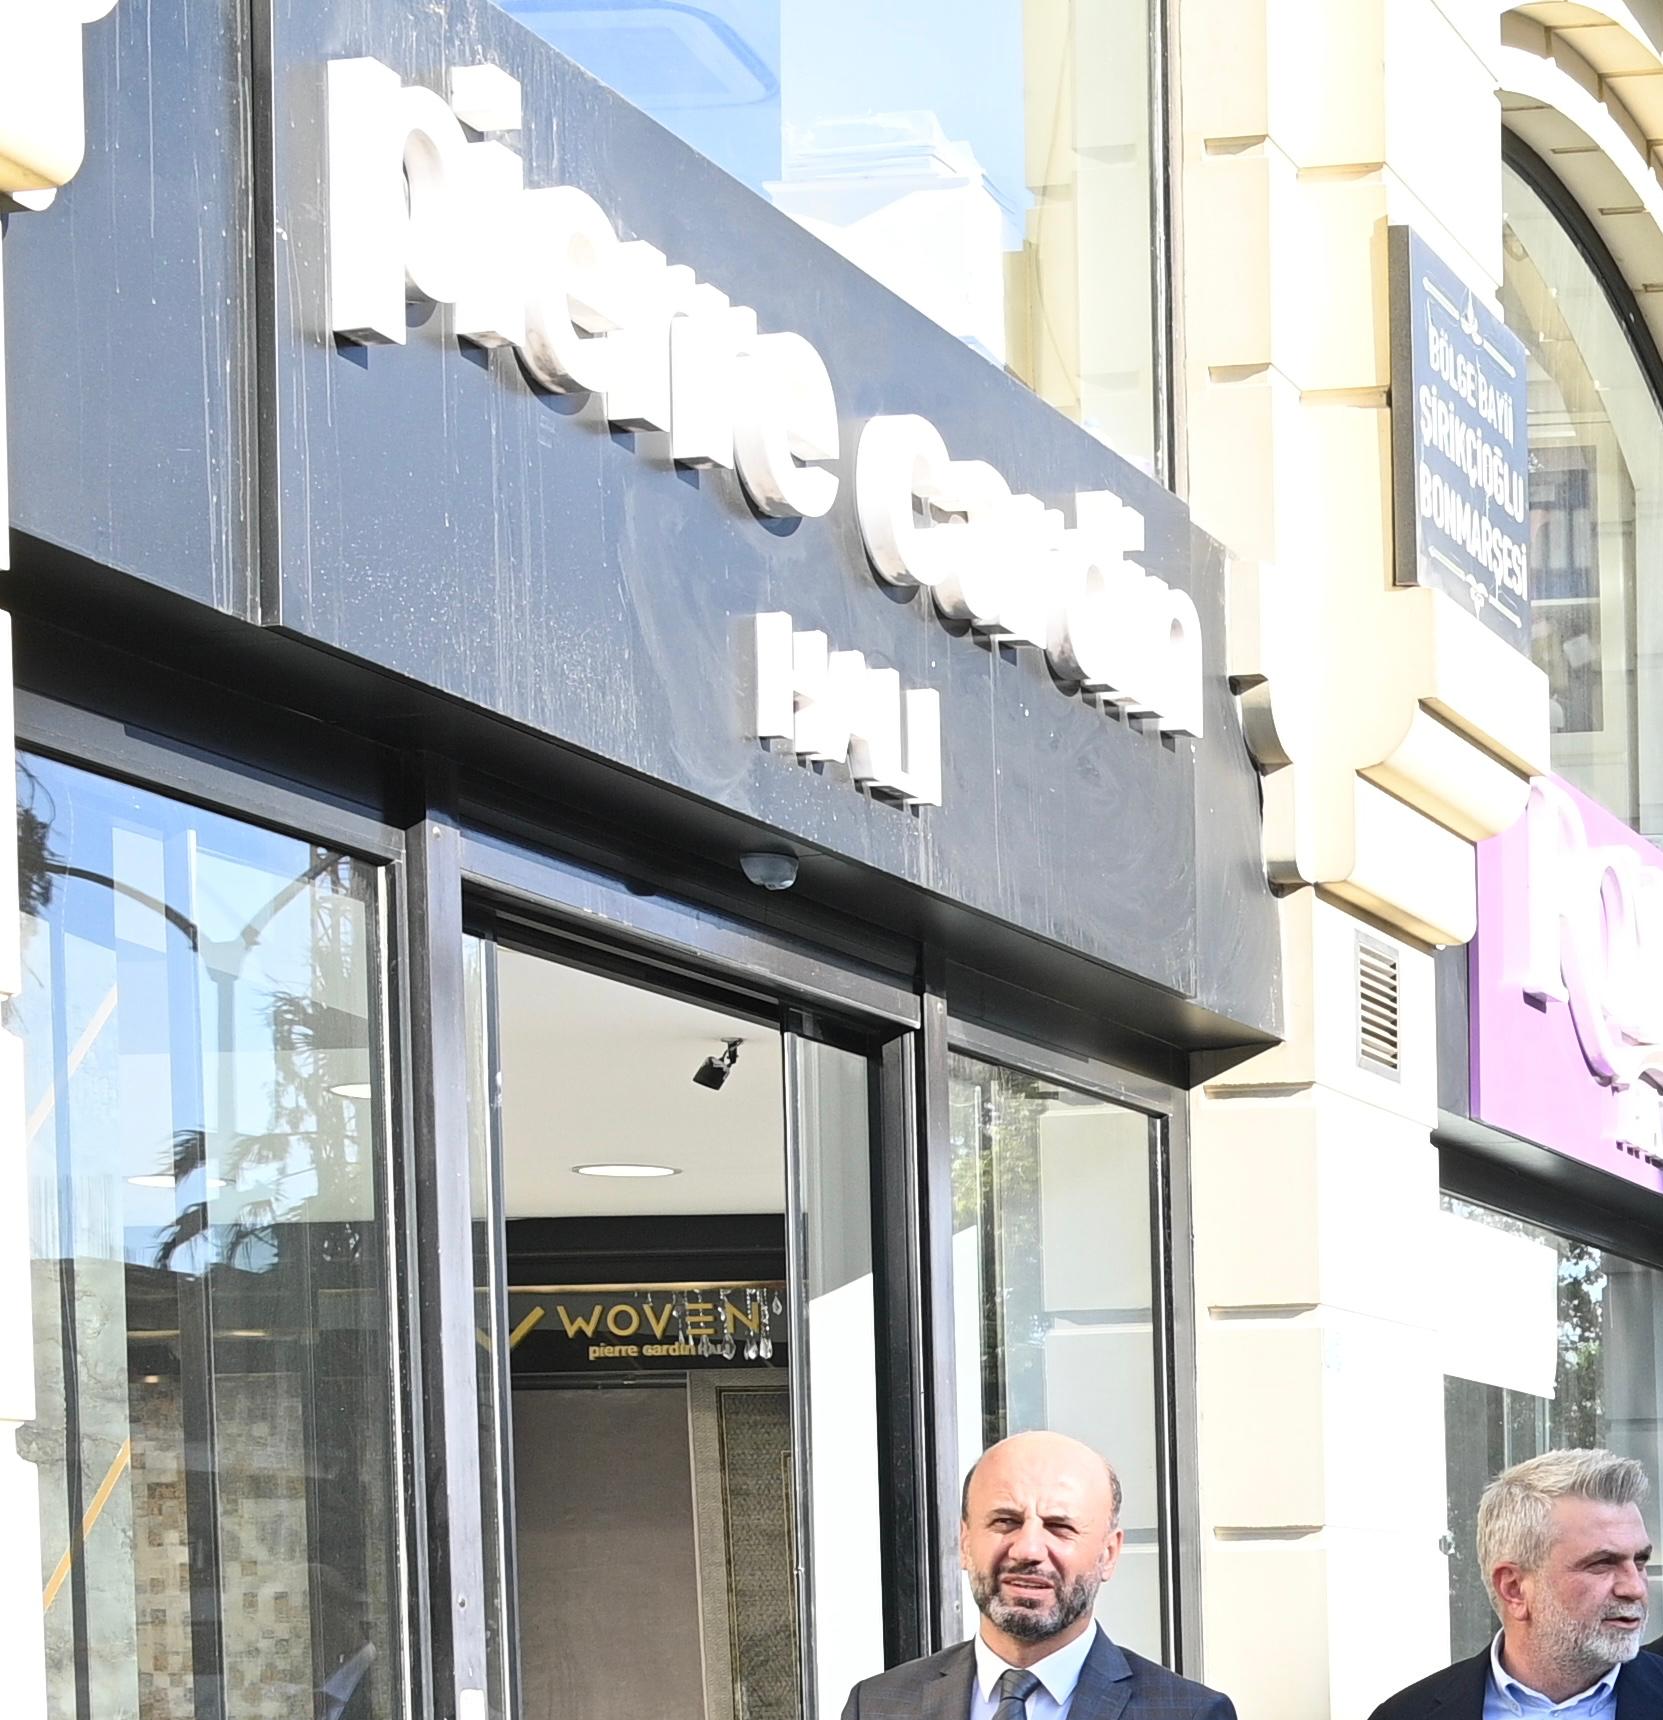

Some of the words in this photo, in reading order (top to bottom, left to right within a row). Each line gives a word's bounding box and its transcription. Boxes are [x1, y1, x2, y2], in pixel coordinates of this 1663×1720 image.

[1428, 322, 1476, 409] BÖLGE
[1419, 384, 1525, 524] ŞİRİKÇİOĞLU
[1419, 459, 1528, 602] BONMARŞESİ
[556, 1301, 760, 1340] WOVEN
